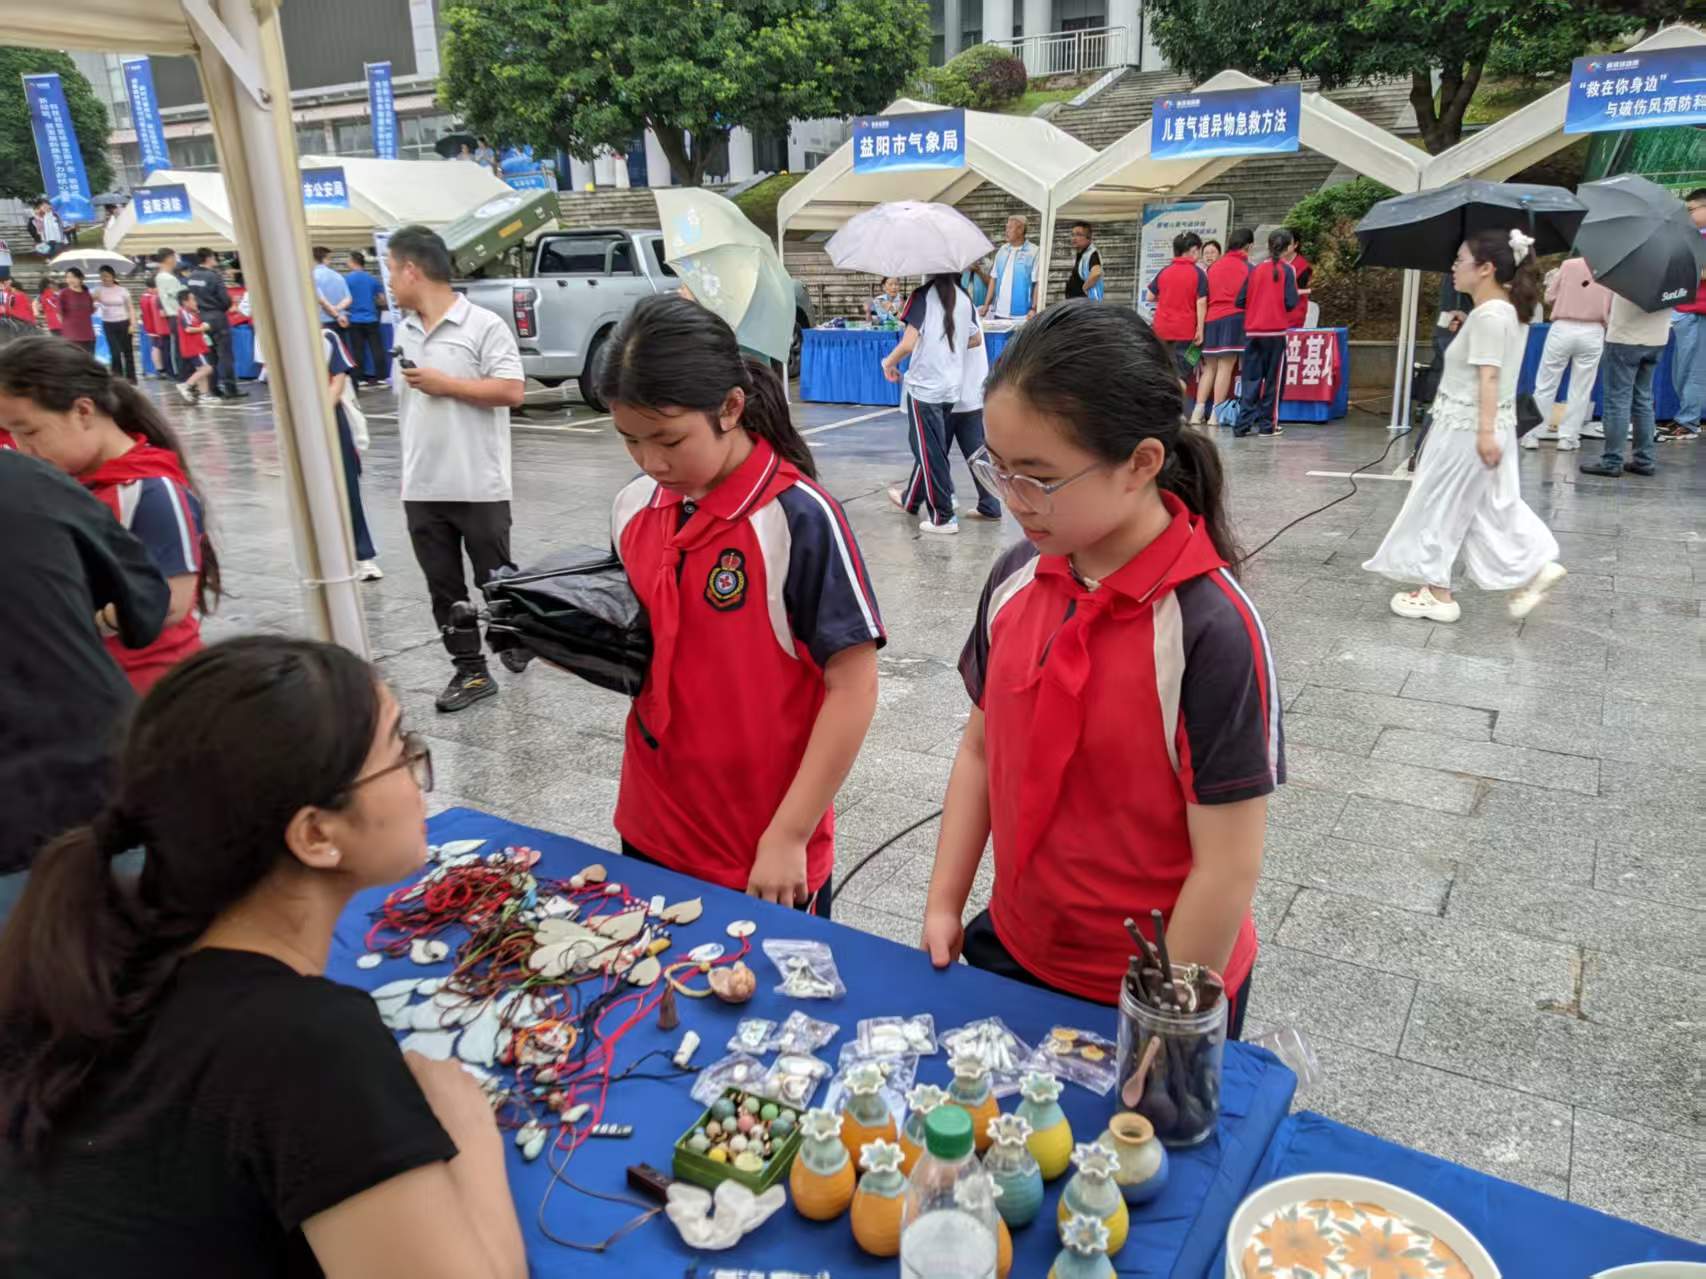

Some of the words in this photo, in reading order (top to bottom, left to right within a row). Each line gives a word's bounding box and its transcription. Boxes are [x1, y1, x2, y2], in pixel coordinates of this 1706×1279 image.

[1161, 107, 1287, 142] 儿童气道异物急救方法
[860, 129, 958, 158] 益阳市气象局
